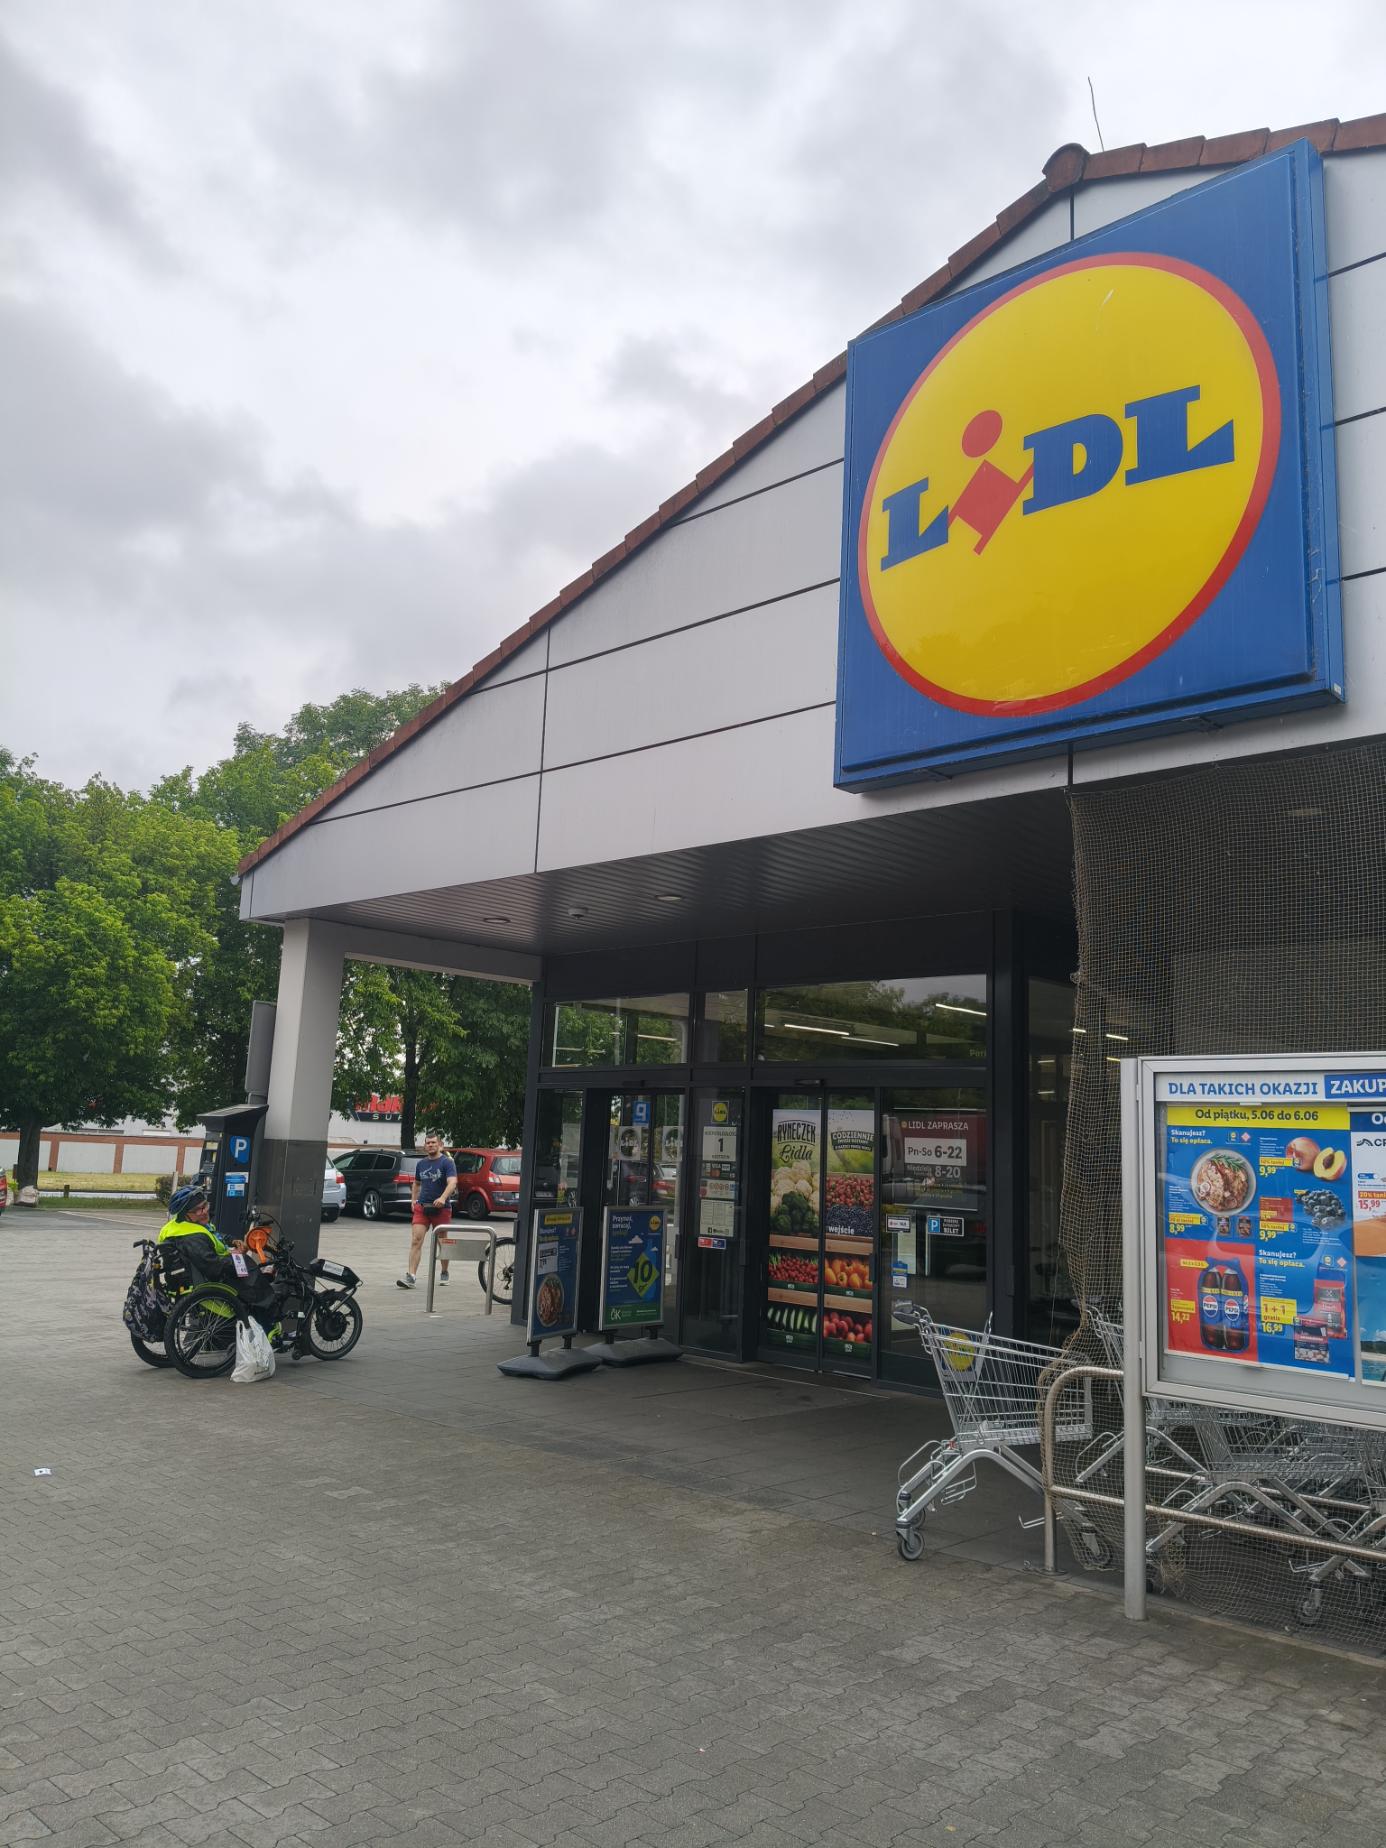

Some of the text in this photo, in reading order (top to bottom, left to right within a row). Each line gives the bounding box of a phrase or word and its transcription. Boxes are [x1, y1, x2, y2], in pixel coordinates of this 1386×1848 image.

[1168, 1082, 1318, 1096] DLA TAKICH OKAZJI
[1195, 1108, 1319, 1122] Od piątku, 5.06 do 6.06
[908, 1120, 969, 1131] LIDL ZAPRASZA
[777, 1121, 816, 1144] RYNECZEK
[234, 1138, 248, 1159] P
[780, 1144, 813, 1163] Lidla
[907, 1145, 963, 1160] Pn-So 6-22
[934, 1165, 961, 1178] 8-20
[1358, 1200, 1381, 1211] 15,99
[828, 1225, 855, 1235] wejście
[931, 1219, 938, 1231] P
[1258, 1249, 1297, 1259] Skanujesz?
